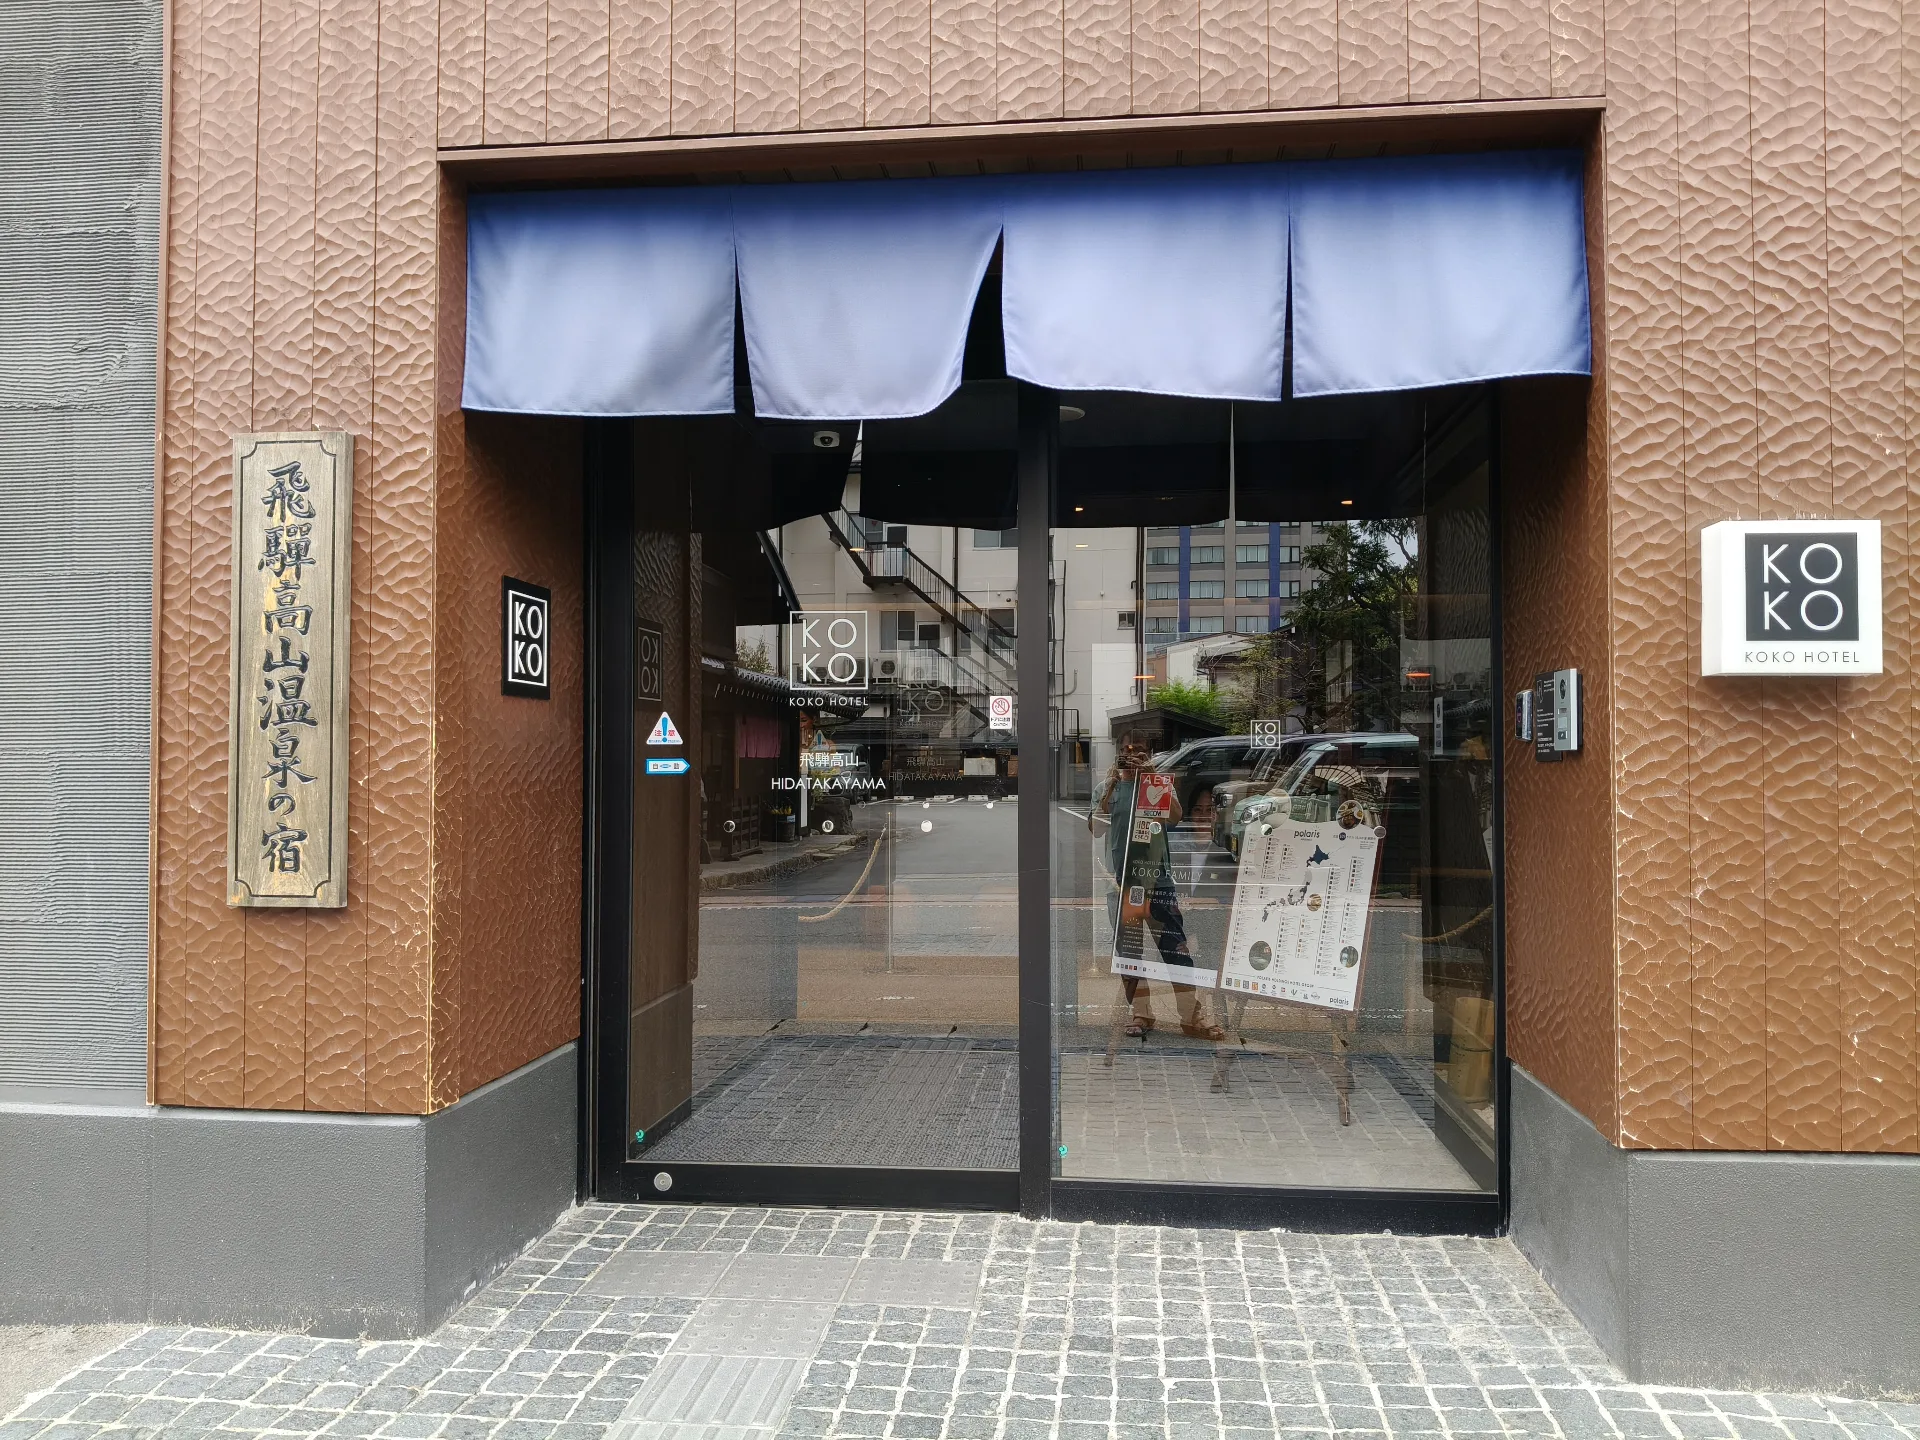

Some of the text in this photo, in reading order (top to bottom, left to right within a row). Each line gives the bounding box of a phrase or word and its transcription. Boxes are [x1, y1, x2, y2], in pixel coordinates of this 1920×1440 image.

[1763, 542, 1843, 584] KO
[1764, 590, 1844, 631] KO
[514, 601, 543, 639] KO
[802, 618, 858, 649] KO
[514, 640, 543, 676] KO
[1745, 651, 1860, 663] KOKO HOTEL
[802, 652, 858, 682] KO
[789, 697, 869, 706] KOKO HOTEL
[1255, 722, 1277, 734] KO
[1255, 735, 1277, 746] KO
[800, 752, 859, 767] 飛騨高山
[771, 777, 887, 790] HIDATAKAYAMA
[1294, 829, 1320, 839] polaris
[1131, 867, 1203, 882] KOKO FAMILY
